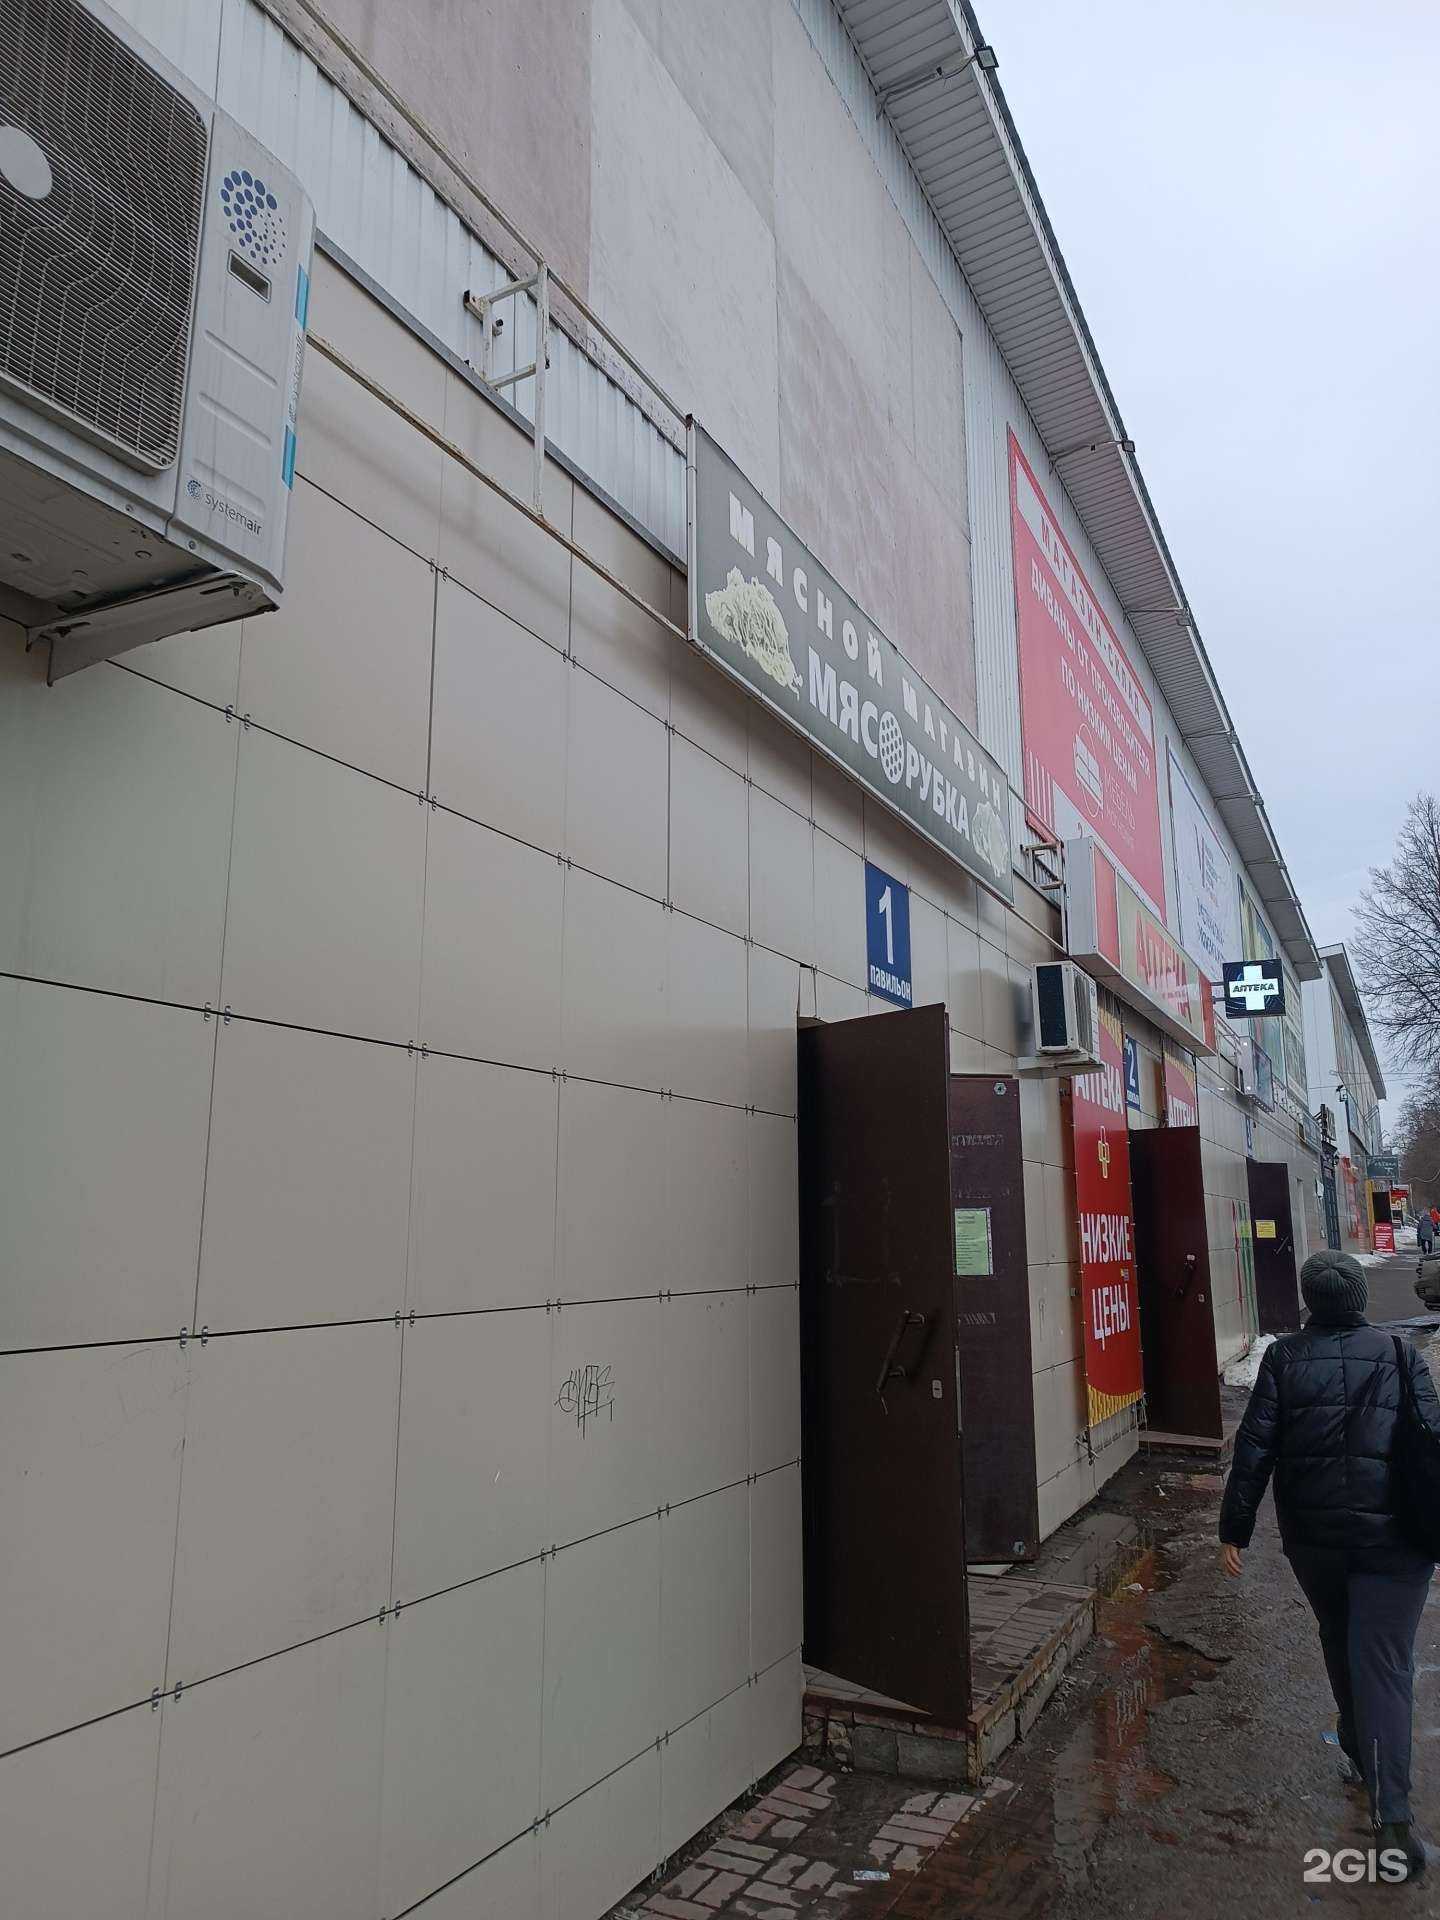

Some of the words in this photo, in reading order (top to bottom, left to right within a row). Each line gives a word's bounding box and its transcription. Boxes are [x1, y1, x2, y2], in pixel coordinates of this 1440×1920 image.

[205, 492, 263, 537] systemair
[728, 490, 883, 687] МЯСНОЙ
[902, 676, 1001, 806] МАГАЗИН
[1040, 514, 1142, 721] МАГАЗИН-СКЛАД
[1031, 558, 1076, 652] ДИВАНЫ
[1077, 642, 1090, 676] ОТ
[1090, 661, 1151, 780] ПРОИЗВОДИТЕЛЯ
[808, 646, 970, 842] МЯСОРУБКА
[1061, 655, 1075, 697] ПО
[1076, 680, 1112, 753] НИЗКИМ
[1112, 739, 1138, 795] ЦЕНАМ
[879, 885, 894, 965] 1
[870, 964, 911, 1001] павильон
[1232, 982, 1275, 993] АПТЕКА
[1127, 1039, 1136, 1088] 2
[1080, 1213, 1132, 1264] НИЗКИЕ
[1092, 1283, 1131, 1351] ЦЕНЫ
